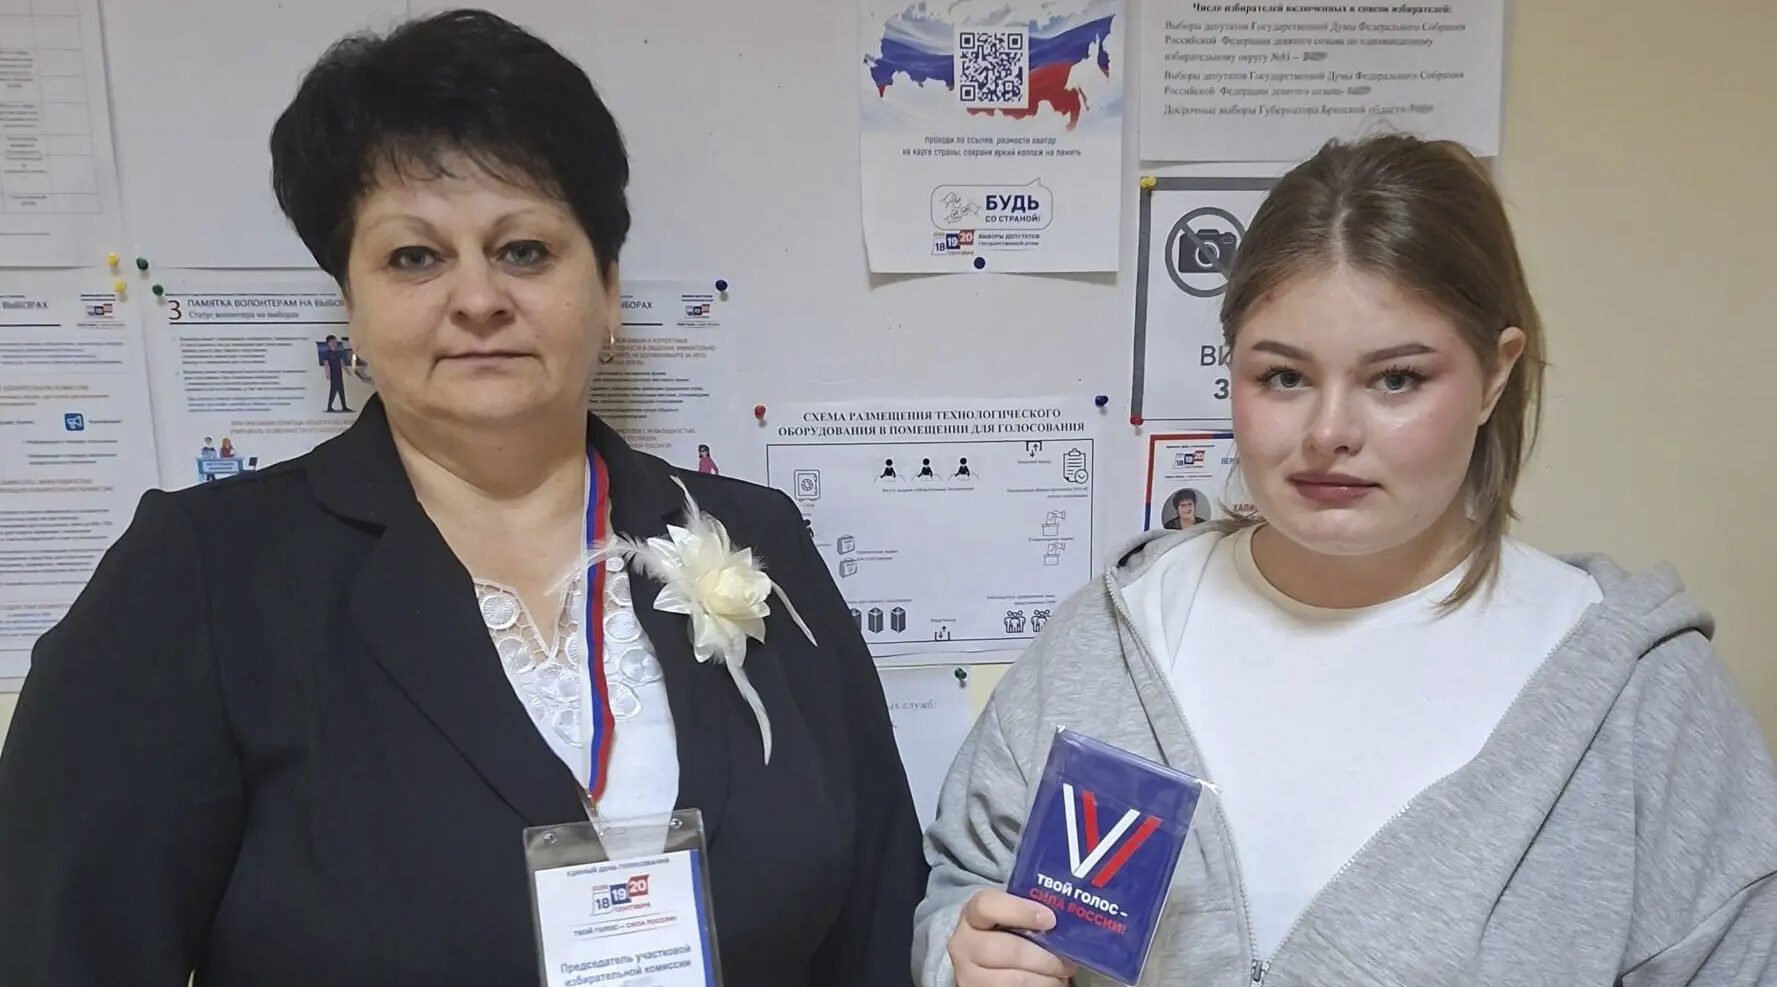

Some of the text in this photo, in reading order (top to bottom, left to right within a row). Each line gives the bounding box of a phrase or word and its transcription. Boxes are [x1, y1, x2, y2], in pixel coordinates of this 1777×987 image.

[1193, 3, 1222, 13] Число
[1224, 3, 1284, 14] избирателей
[1165, 21, 1202, 32] Выборы
[1329, 22, 1357, 33] Думы
[1165, 35, 1217, 45] Российской
[1164, 70, 1201, 81] Выборы
[1327, 71, 1353, 82] Думы
[1420, 70, 1464, 81] Собрания
[1164, 86, 1216, 96] Российской
[1219, 105, 1257, 116] выборы
[1259, 105, 1319, 116] Губернатора
[985, 194, 1040, 213] БУДЬ
[985, 215, 997, 223] СО
[935, 231, 973, 252] 18 19 20
[168, 299, 183, 321] 3
[187, 299, 232, 308] ПАМЯТКА
[234, 299, 297, 308] ВОЛОНТЕРАМ
[299, 300, 313, 308] НА
[803, 408, 1061, 422] СХЕМА РАЗМЕЩЕНИЯ ТЕХНОЛОГИЧЕСКОГО
[778, 422, 1085, 437] ОБОРУДОВАНИЯ В ПОМЕЩЕНИИ ДЛЯ ГОЛОСОВАНИЯ
[596, 880, 646, 910] 18 19 20
[1037, 873, 1073, 897] ТВОЙ
[1073, 888, 1119, 916] ГОЛОС
[1028, 887, 1127, 936] СИЛА РОССИИ!
[560, 943, 692, 974] Председатель участковой
[564, 959, 692, 987] избирательной комиссии
